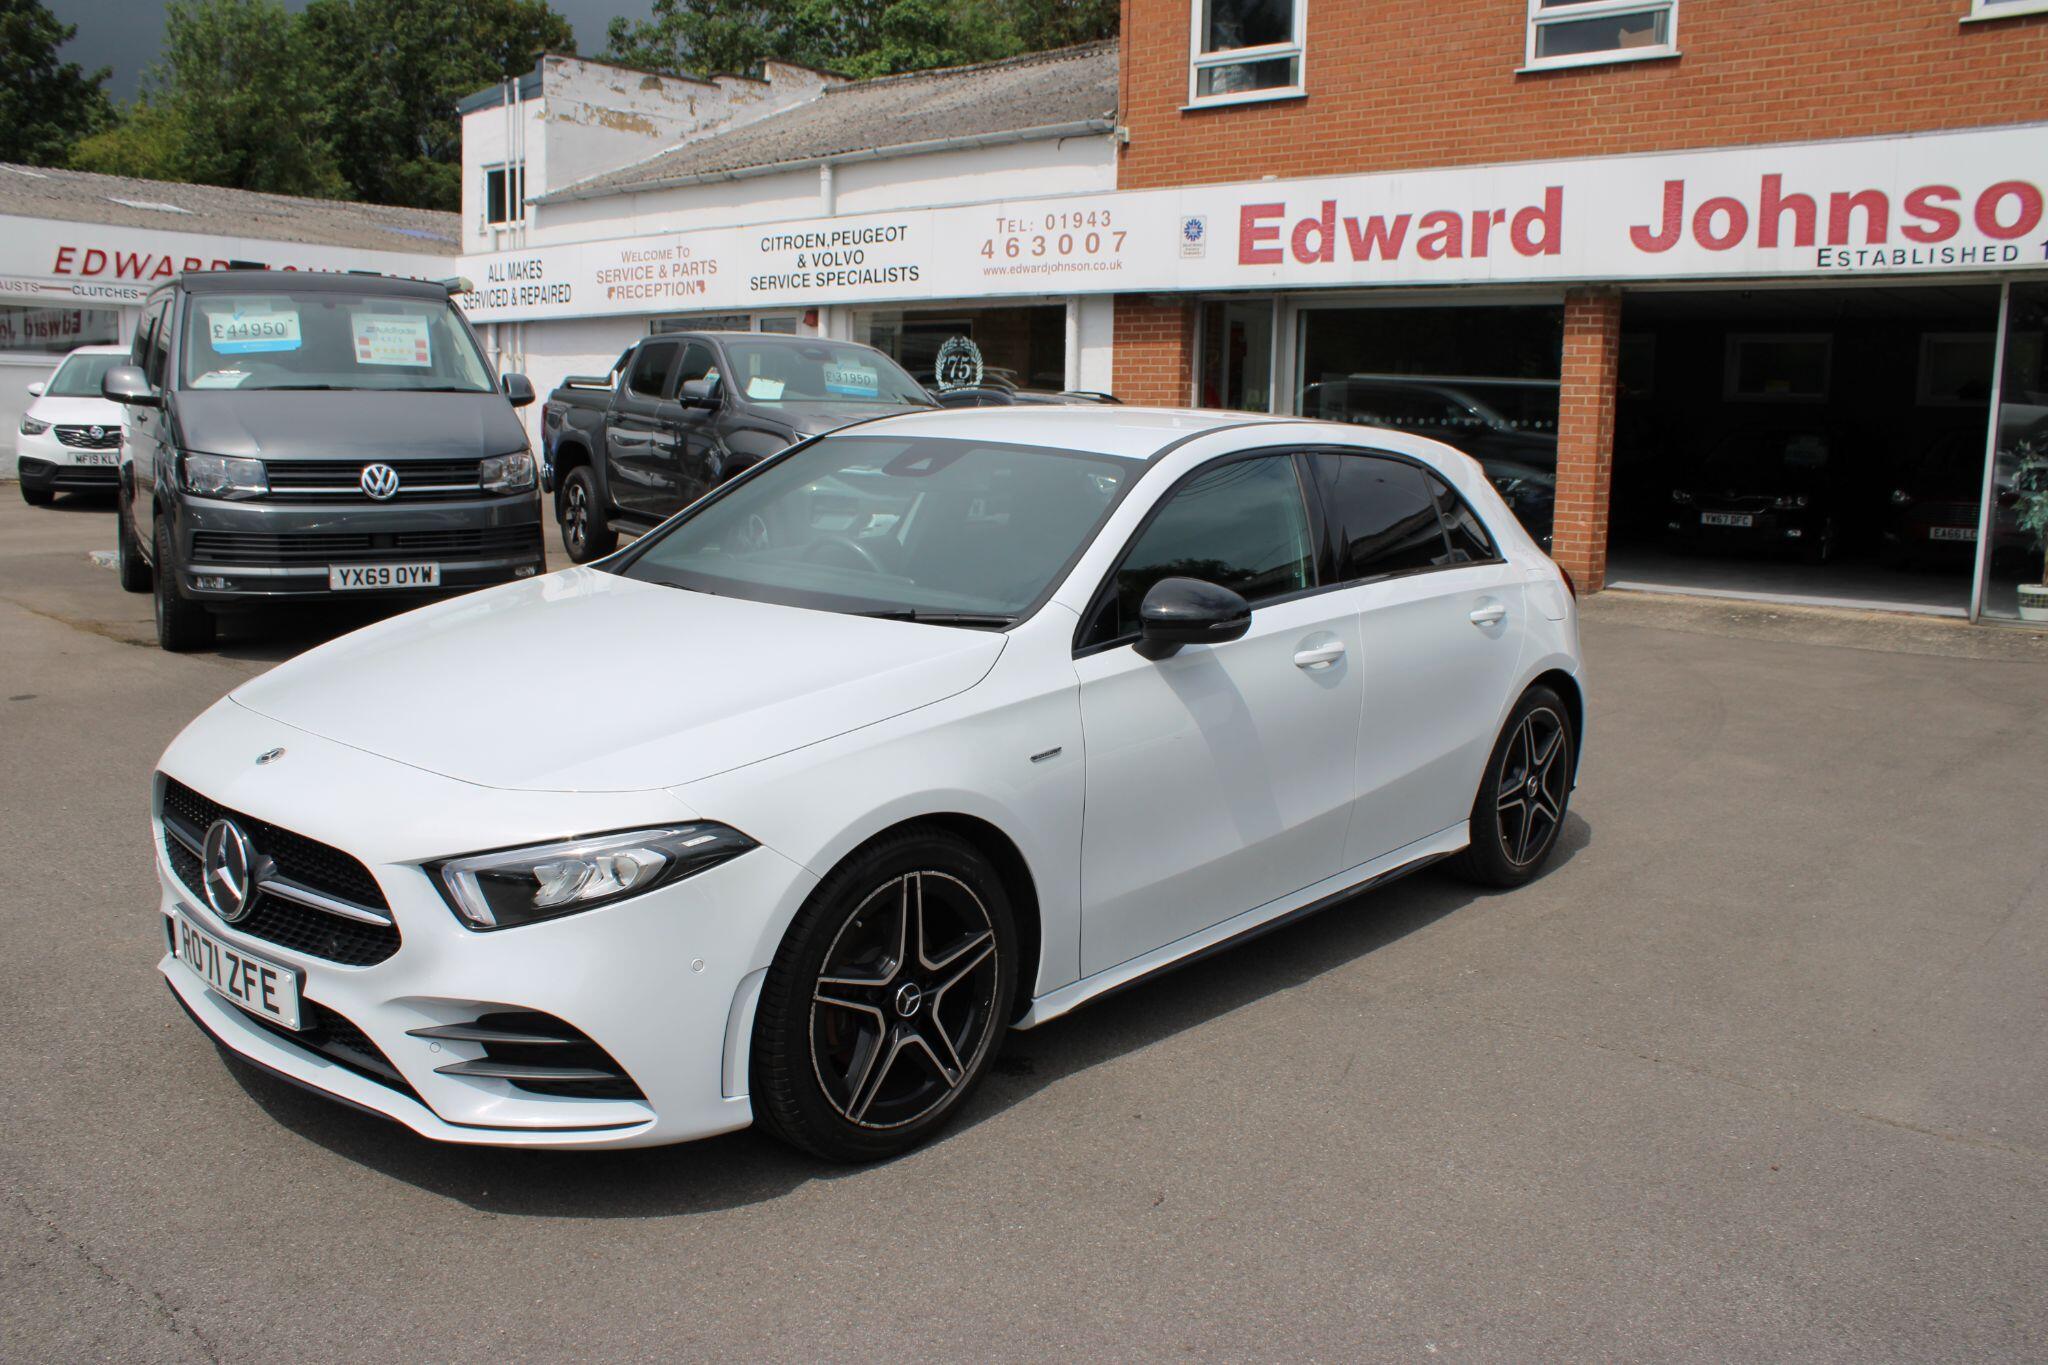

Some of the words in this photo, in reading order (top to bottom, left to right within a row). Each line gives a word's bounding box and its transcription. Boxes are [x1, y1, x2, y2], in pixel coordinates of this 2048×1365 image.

[1045, 210, 1111, 231] 01943
[1238, 185, 1564, 265] Edward
[1629, 173, 2045, 253] Johnso
[797, 253, 807, 268] &
[811, 250, 865, 267] VOLVO
[983, 259, 1123, 276] www.edwardjohnson.co.uk
[1817, 245, 2019, 268] ESTABLISHED
[488, 264, 505, 282] ALL
[508, 259, 543, 280] MAKES
[596, 265, 654, 284] SERVICE
[659, 264, 667, 279] &
[672, 259, 718, 277] PARTS
[750, 273, 811, 291] SERVICE
[816, 265, 920, 287] SPECIALISTS
[72, 285, 138, 299] CLUTCHES
[463, 287, 509, 310] SERVICED
[511, 287, 518, 306] &
[520, 283, 571, 305] REPAIRED
[616, 281, 695, 299] RECEPTION
[947, 355, 971, 379] 75
[339, 568, 390, 586] YX69
[396, 566, 433, 584] OYW
[181, 919, 222, 986] RO71
[225, 951, 280, 1015] ZFE
